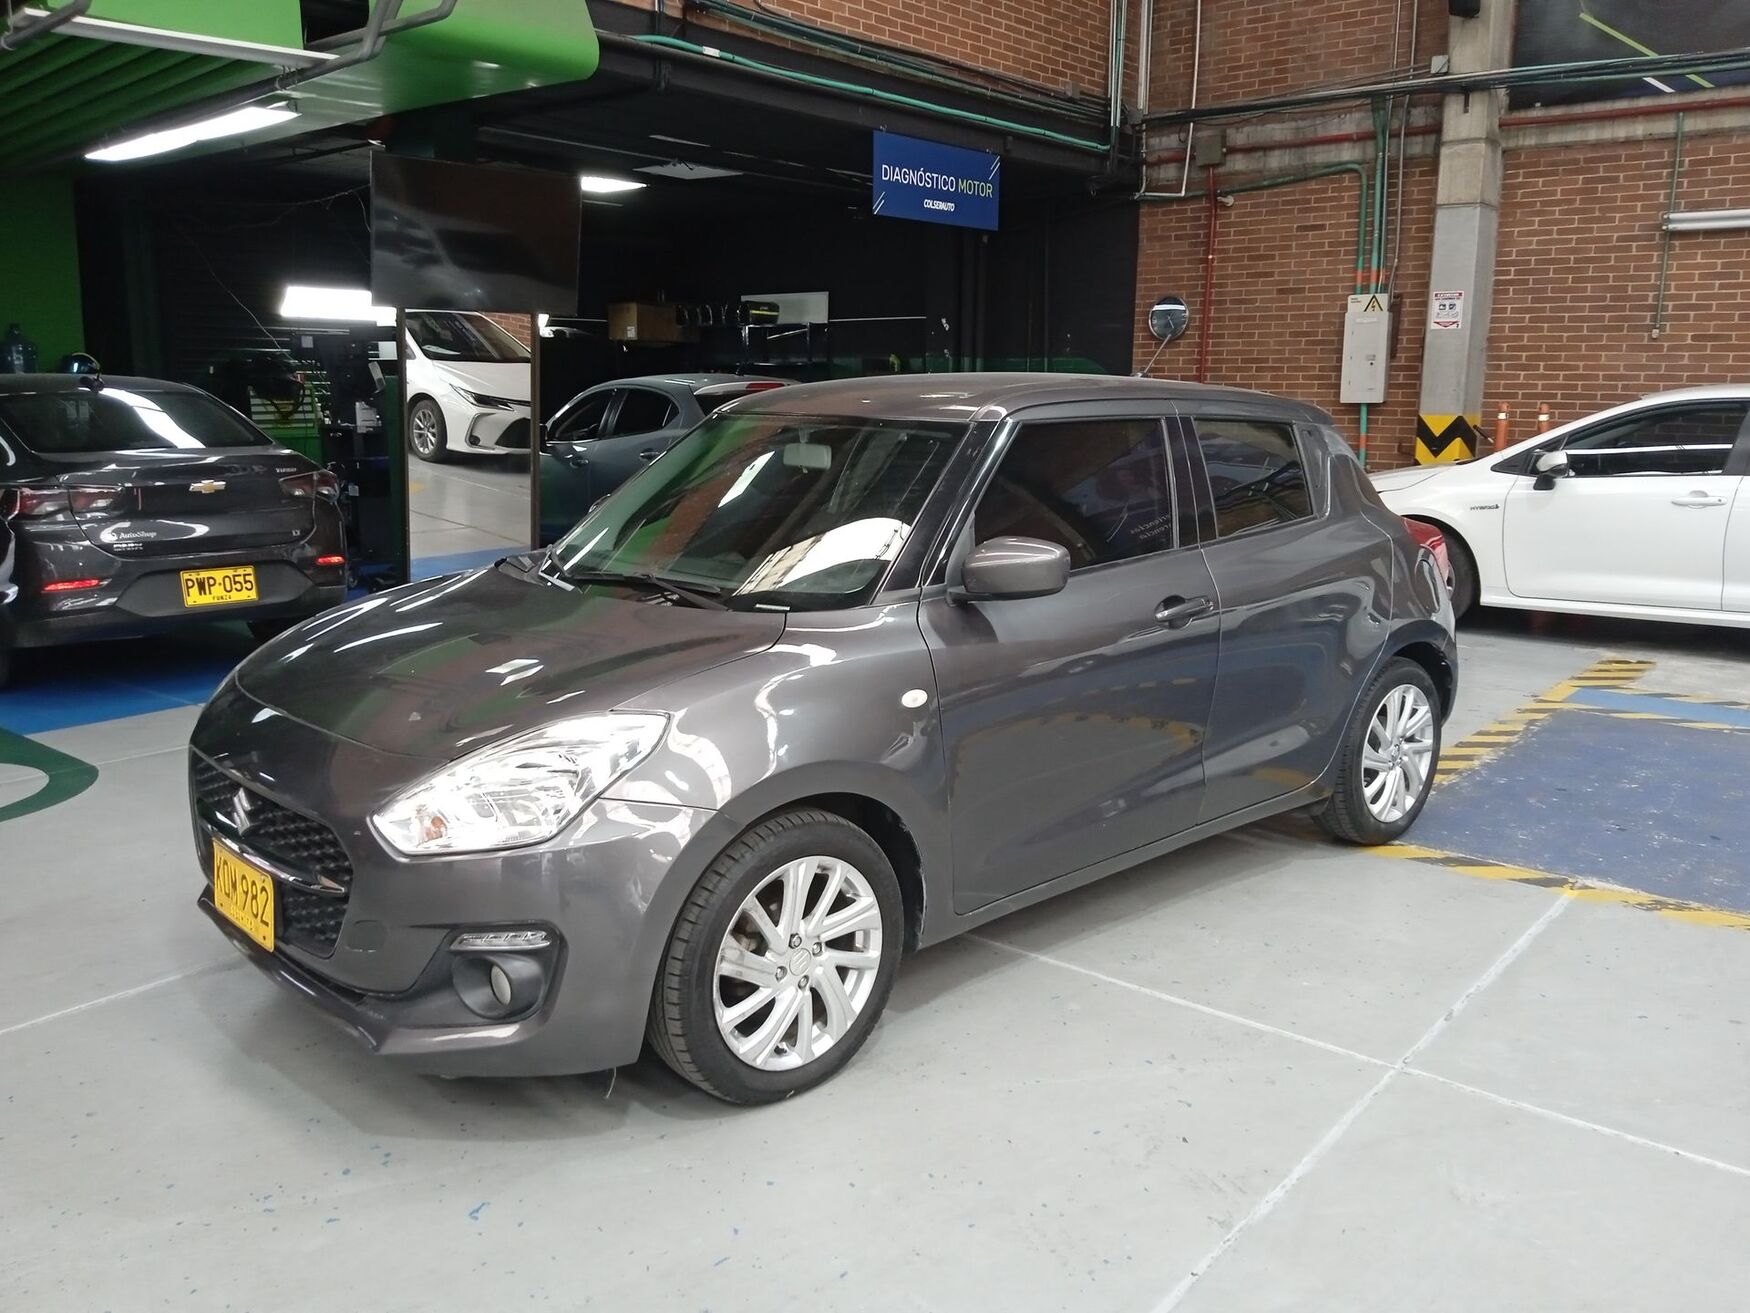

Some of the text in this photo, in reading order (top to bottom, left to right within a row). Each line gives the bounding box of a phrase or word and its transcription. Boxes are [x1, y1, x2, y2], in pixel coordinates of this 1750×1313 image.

[881, 164, 993, 198] DIAGNÓSTICO MOTOR
[923, 198, 955, 212] COLSERAUTO
[119, 530, 157, 539] AutoShop
[241, 873, 270, 928] 982
